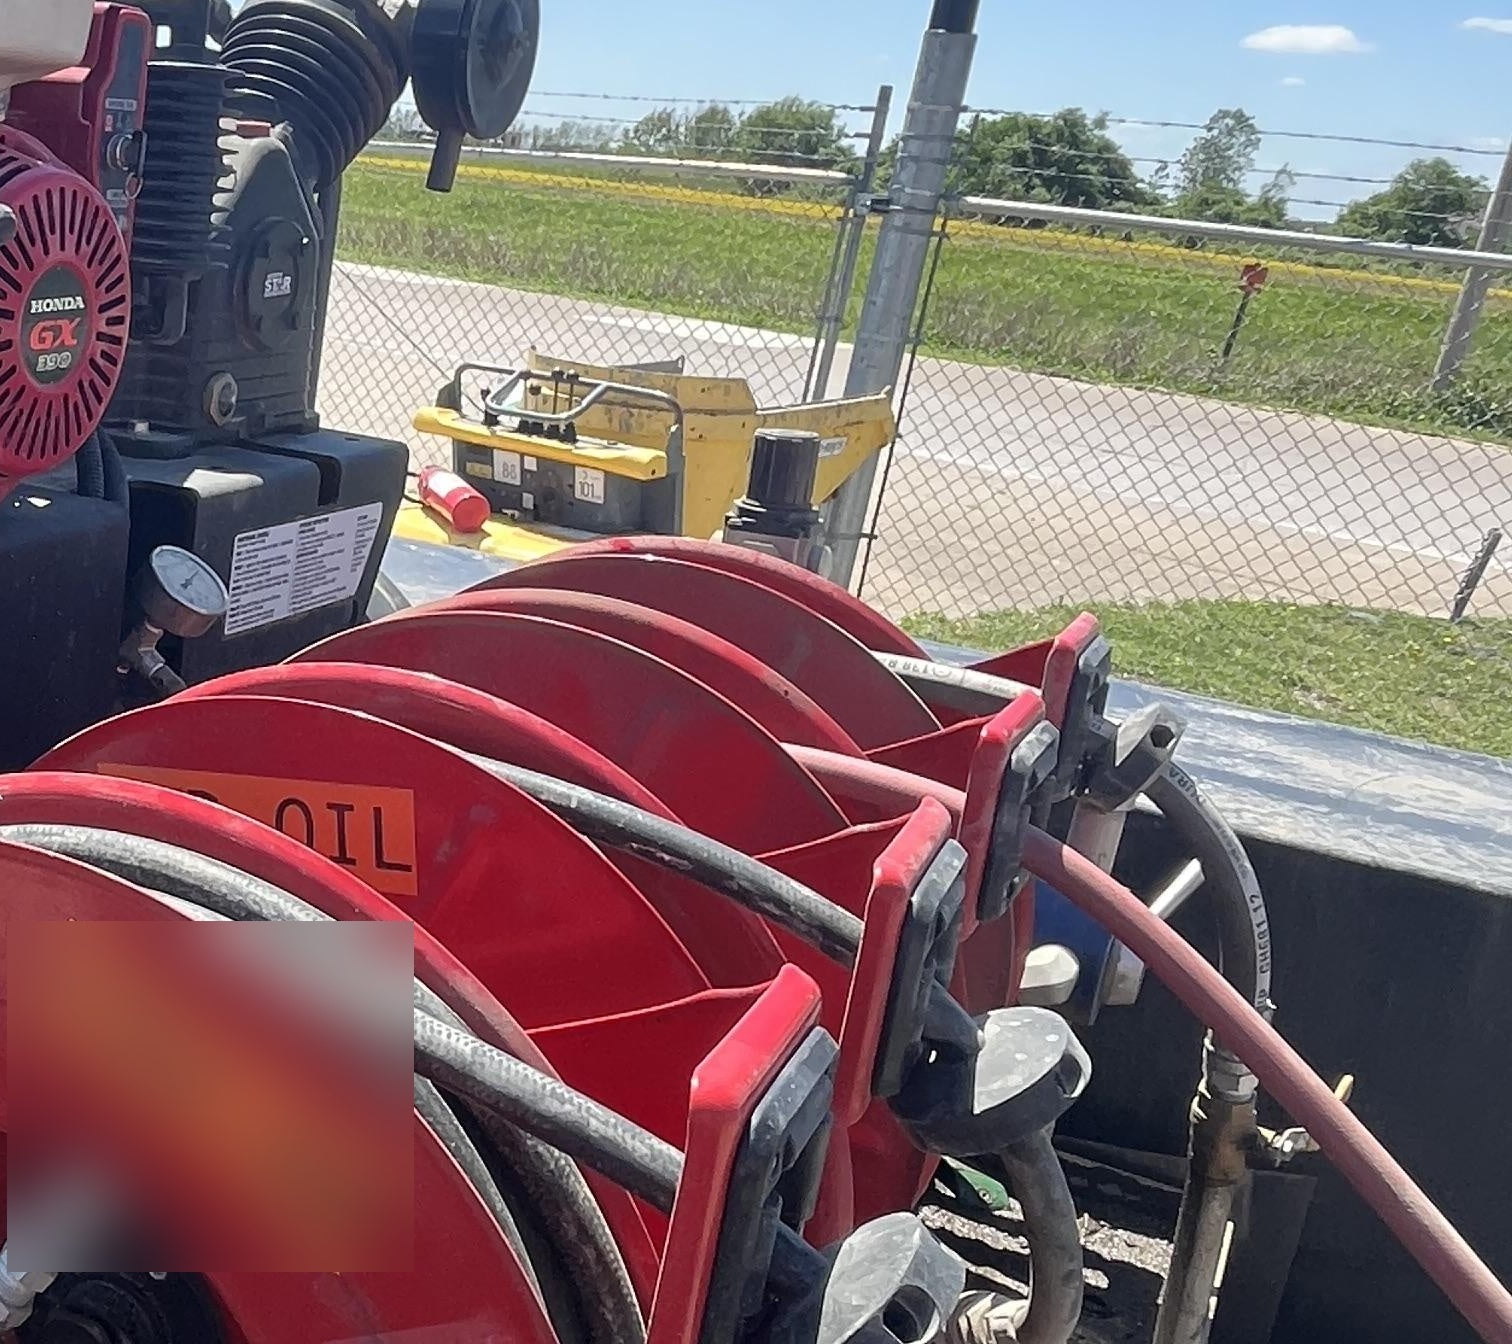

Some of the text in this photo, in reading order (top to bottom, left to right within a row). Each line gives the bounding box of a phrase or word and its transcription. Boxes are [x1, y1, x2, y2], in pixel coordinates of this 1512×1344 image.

[30, 296, 85, 314] HONDA
[30, 317, 81, 350] GX
[36, 351, 72, 372] 390
[274, 797, 413, 873] OIL
